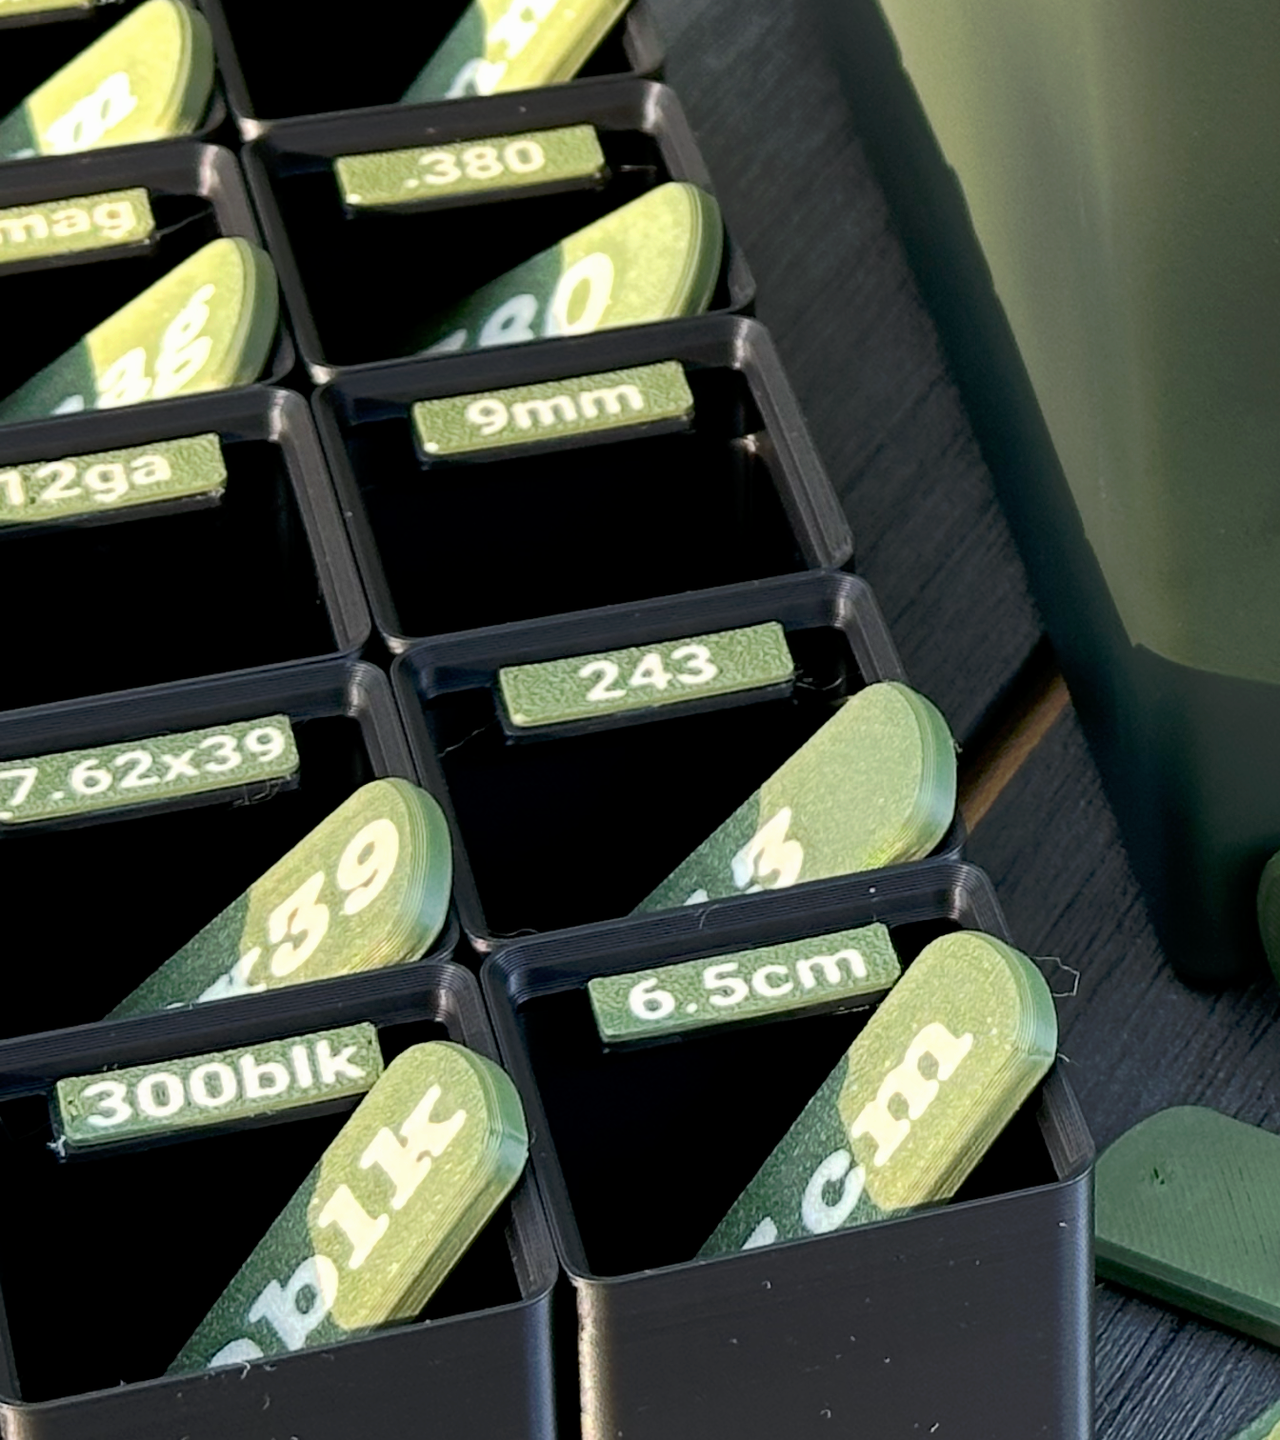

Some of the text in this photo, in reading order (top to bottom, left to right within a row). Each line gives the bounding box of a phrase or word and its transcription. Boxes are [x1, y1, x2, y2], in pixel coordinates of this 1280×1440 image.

[404, 140, 545, 188] .380
[466, 384, 644, 436] 9mm
[0, 454, 172, 506] 12ga
[579, 644, 719, 701] 243
[0, 726, 286, 806] 7.62x39
[628, 948, 867, 1020] 6.5cm
[82, 1039, 366, 1127] 300blk
